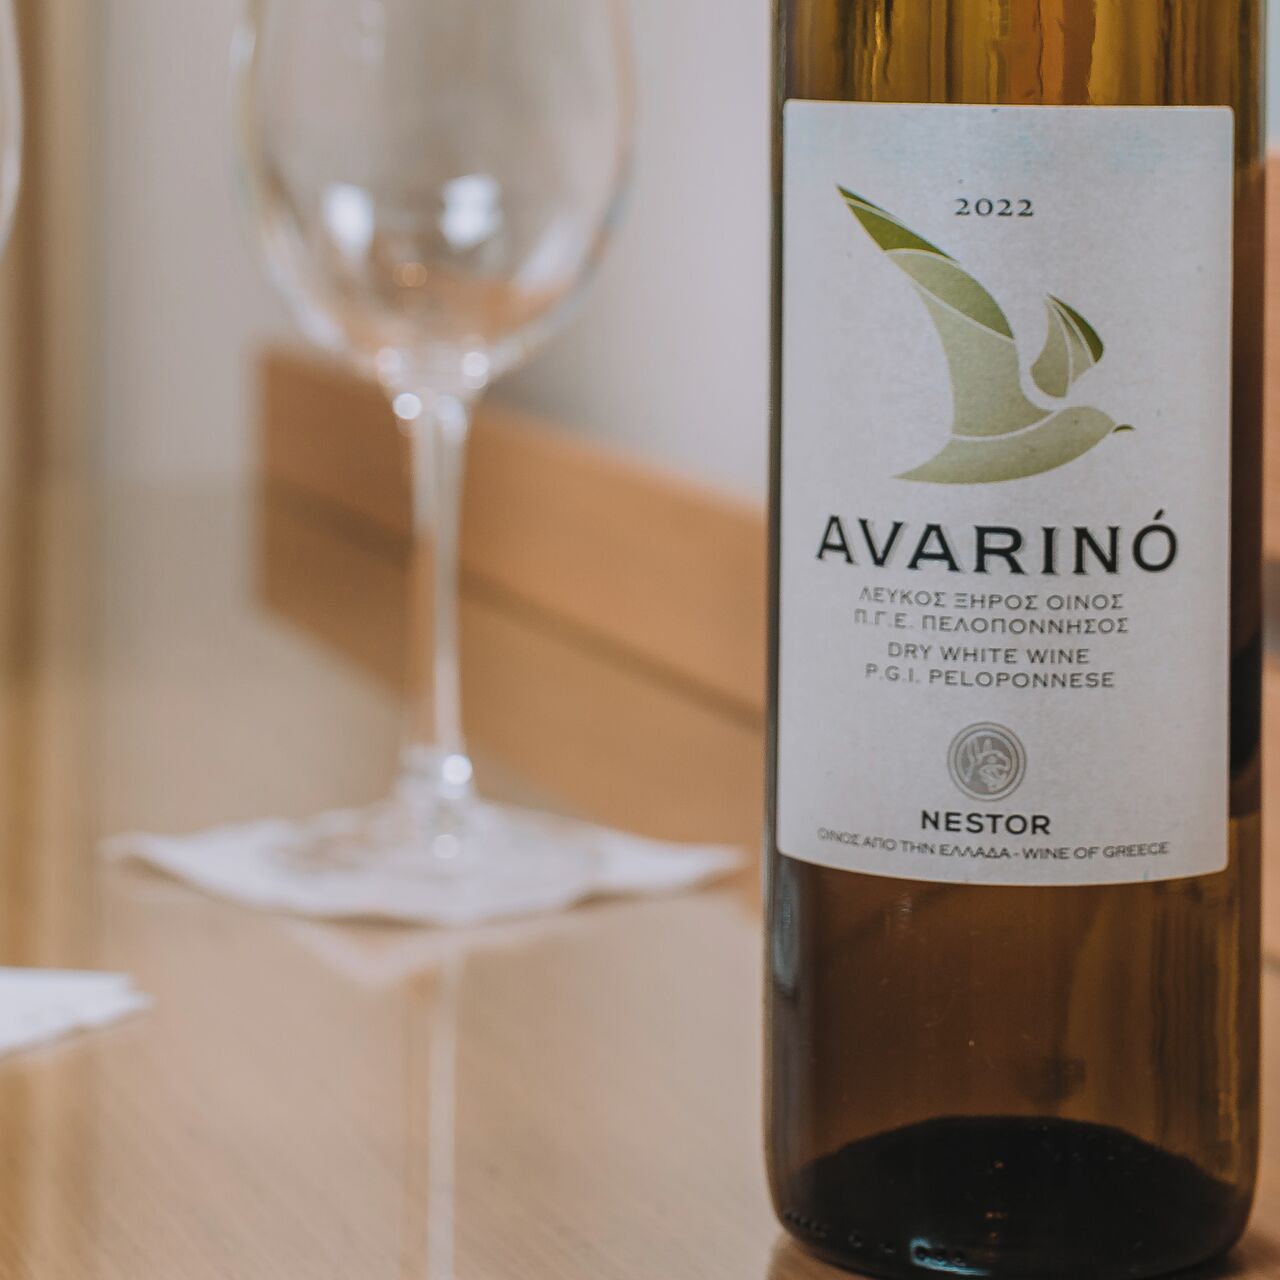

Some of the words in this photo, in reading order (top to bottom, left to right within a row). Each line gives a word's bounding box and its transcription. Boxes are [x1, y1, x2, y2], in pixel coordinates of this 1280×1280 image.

[953, 196, 1036, 218] 2022
[816, 509, 1179, 576] AVARINÓ
[858, 586, 947, 609] ΛΕΥΚΟΣ
[953, 592, 1039, 611] ΞΗΡΟΣ
[1046, 593, 1124, 611] ΟΙΝΟΣ
[921, 614, 1129, 635] ΠΕΛΟΠΟΝΝΗΣΟΣ
[887, 641, 933, 661] DRY
[940, 646, 1019, 665] WHITE
[1026, 648, 1091, 665] WINE
[864, 663, 922, 684] P.G.I.
[928, 668, 1116, 689] PELOPONNESE
[921, 810, 1052, 836] NESTOR
[1022, 846, 1070, 860] WINE
[1073, 846, 1101, 860] OF
[1102, 841, 1171, 859] GREECE
